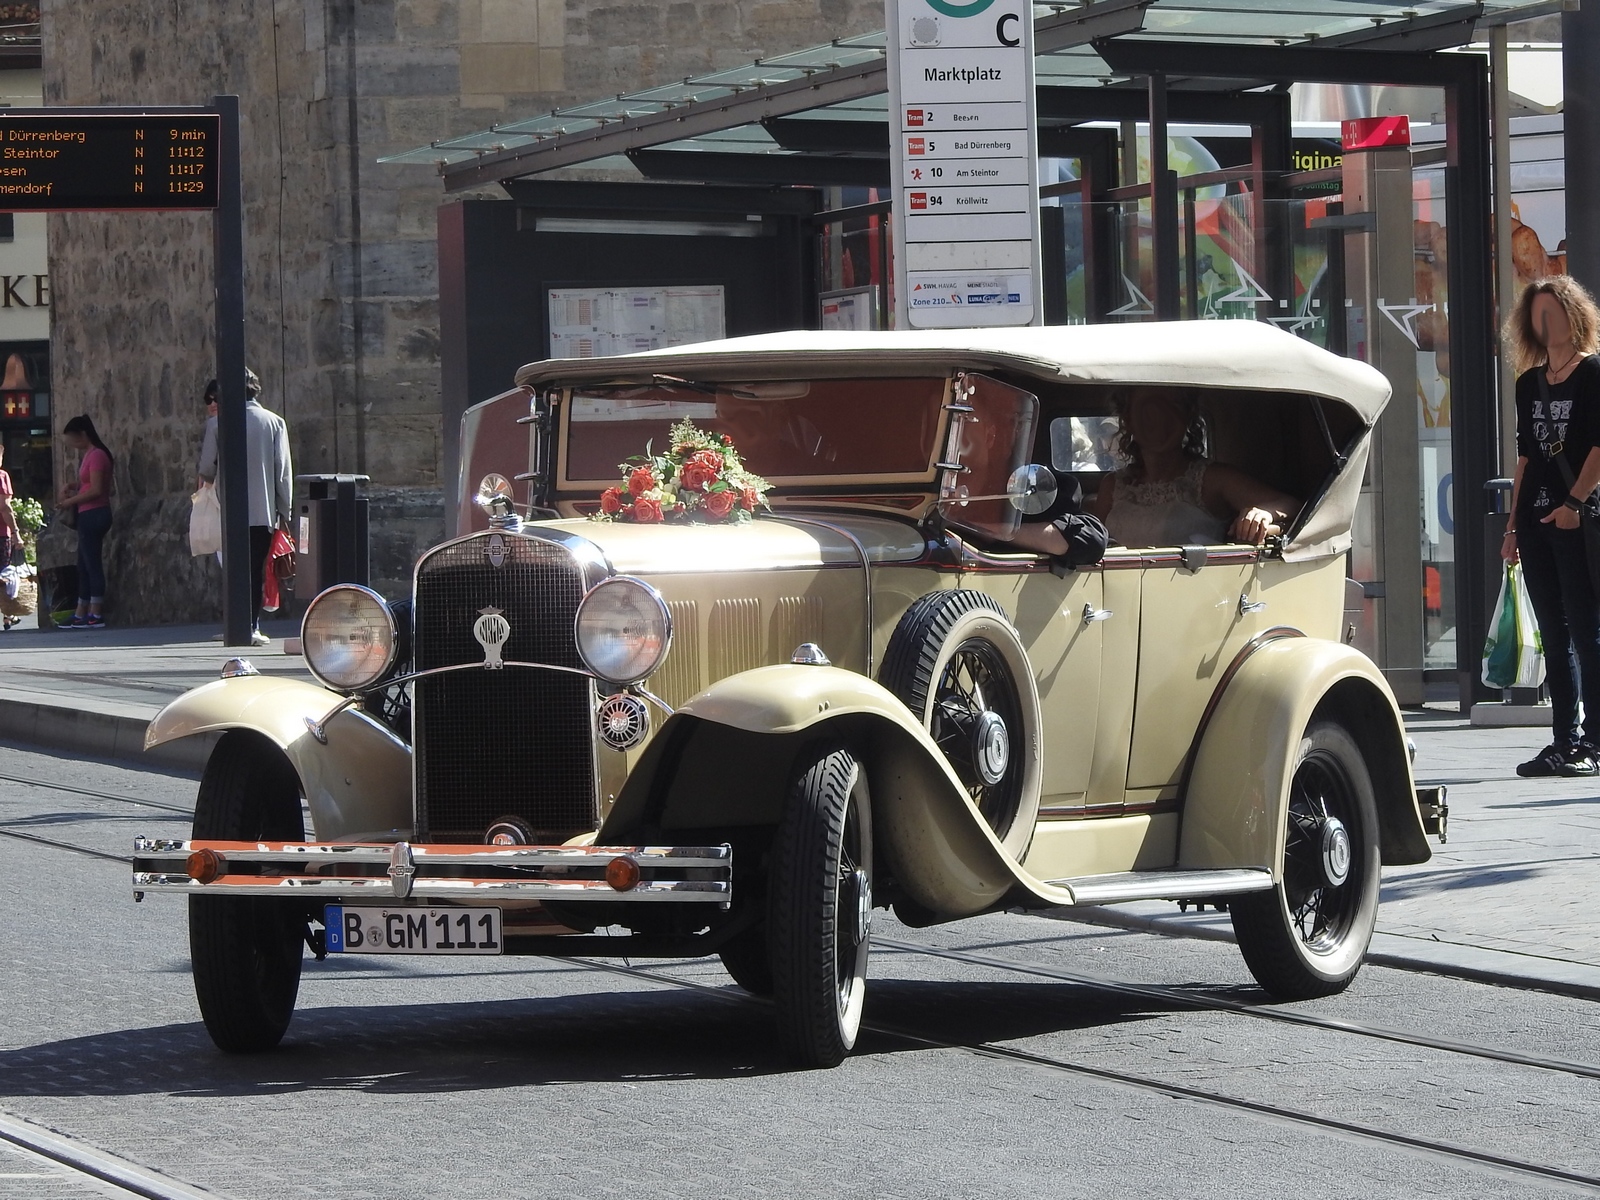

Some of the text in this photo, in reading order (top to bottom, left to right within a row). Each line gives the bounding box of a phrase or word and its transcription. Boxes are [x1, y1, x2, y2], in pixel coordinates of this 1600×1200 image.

[996, 13, 1020, 47] C
[924, 66, 1002, 84] Marktplatz
[927, 112, 934, 122] 2
[9, 130, 85, 143] Dürrenberg
[135, 129, 144, 140] N
[169, 129, 178, 140] 9
[181, 129, 206, 140] min
[929, 141, 935, 151] 5
[954, 141, 968, 149] Bad
[970, 140, 1011, 151] Dürrenberg
[4, 147, 204, 158] Steintor N 11:12
[0, 164, 204, 176] sen N 11:17
[930, 167, 943, 177] 10
[970, 169, 999, 177] Steintor
[134, 181, 143, 193] N
[169, 181, 204, 193] 11:29
[930, 195, 943, 206] 94
[956, 197, 988, 205] Kröllwitz
[331, 913, 498, 949] D B GM 111
